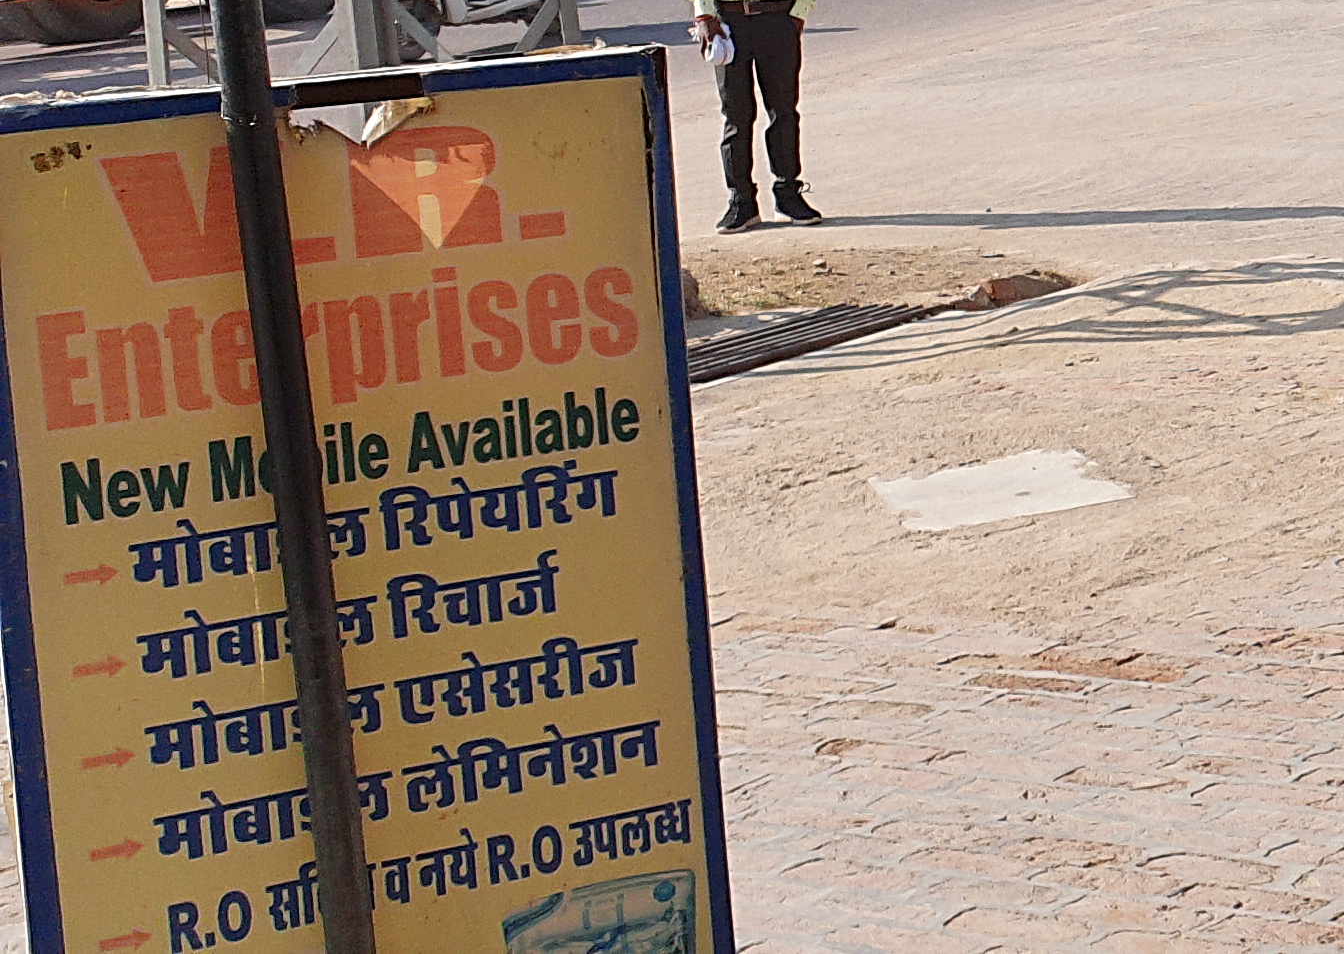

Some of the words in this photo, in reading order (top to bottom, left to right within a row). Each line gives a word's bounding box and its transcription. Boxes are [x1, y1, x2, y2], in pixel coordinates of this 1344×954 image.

[60, 458, 190, 525] New
[208, 422, 389, 502] Moile
[406, 387, 640, 474] Available
[129, 507, 370, 589] मोबाल
[380, 458, 619, 551] रिपेयरिंग
[136, 595, 376, 679] मोबाल
[386, 548, 561, 639] रिचार्ज
[145, 683, 385, 771] मोबाल
[394, 636, 639, 725] एसेसरीज
[402, 719, 661, 813] लेमिनेशन
[167, 890, 254, 954] R.O
[386, 853, 413, 906] व
[416, 828, 479, 896] नये
[487, 824, 564, 885] R.O
[570, 798, 692, 867] उपलब्ध
